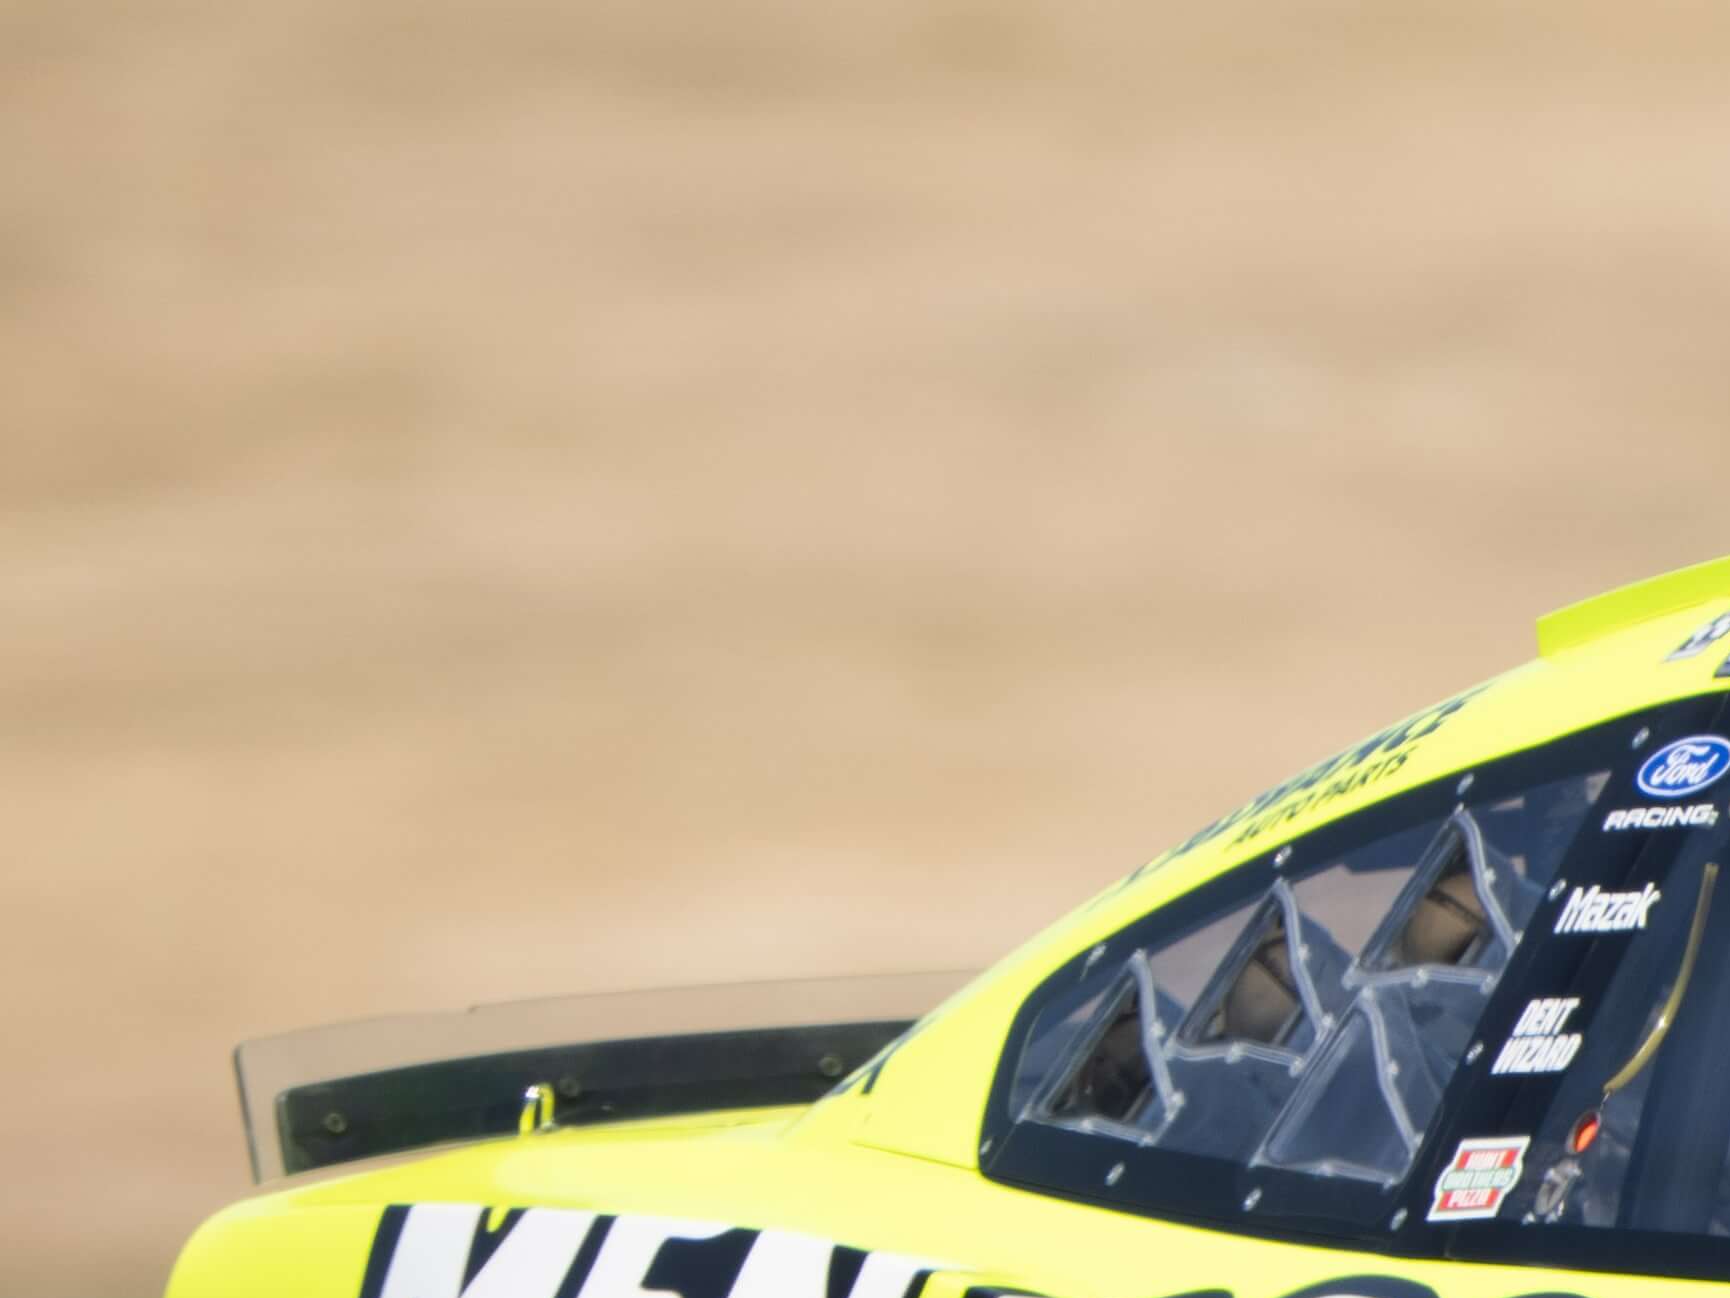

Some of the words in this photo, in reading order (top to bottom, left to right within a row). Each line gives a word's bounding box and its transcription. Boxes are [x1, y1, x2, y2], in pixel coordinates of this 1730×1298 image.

[1650, 744, 1720, 787] Ford
[1603, 804, 1714, 832] RACING
[1554, 881, 1661, 934] Mazak
[1512, 997, 1580, 1036] DENT
[1490, 1033, 1582, 1075] WIZARD
